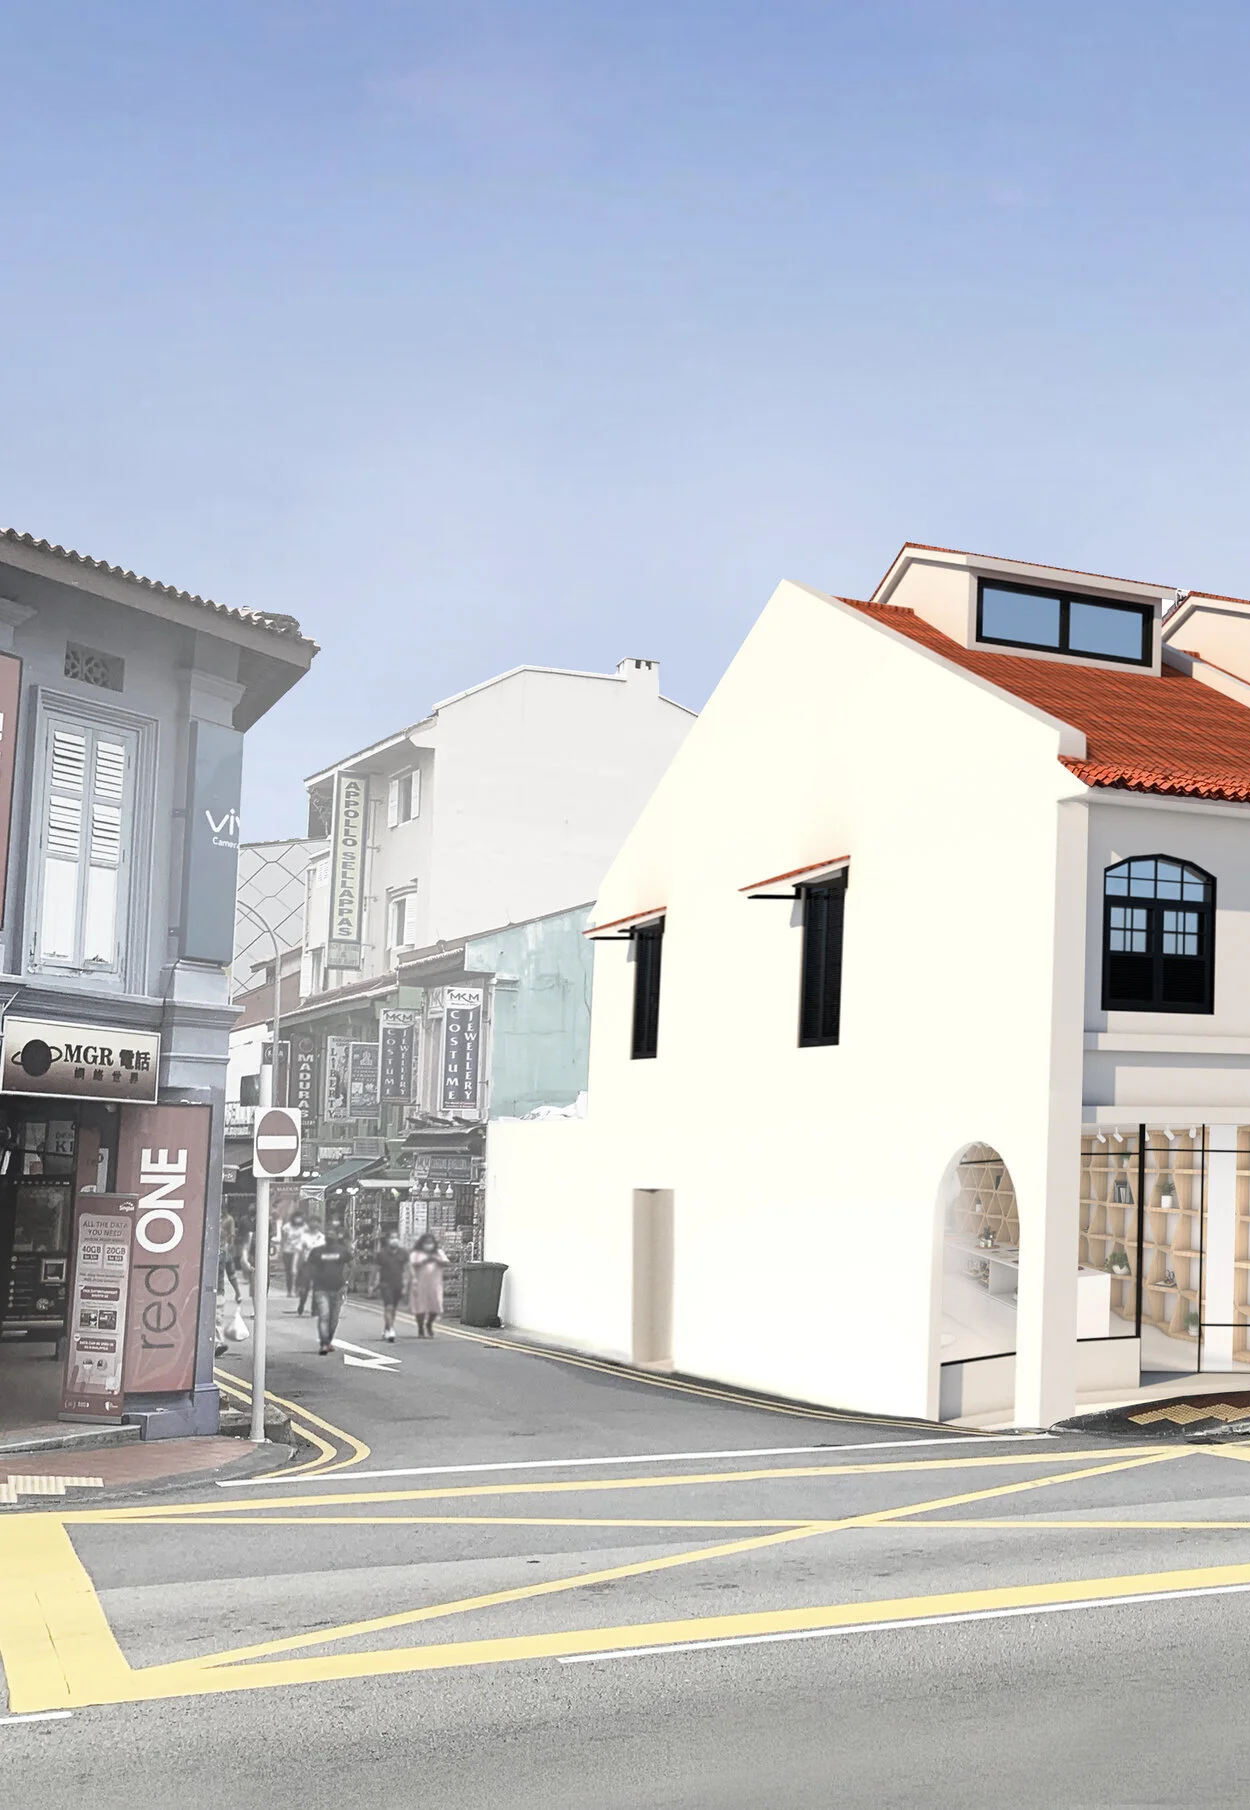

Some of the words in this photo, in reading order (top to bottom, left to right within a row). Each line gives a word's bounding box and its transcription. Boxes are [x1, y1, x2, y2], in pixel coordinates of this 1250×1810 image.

[342, 781, 360, 847] APPOLLO
[337, 851, 357, 937] SELLAPPAS
[386, 1013, 413, 1023] MKM
[450, 992, 480, 1004] MKM
[63, 1043, 114, 1067] MGR
[119, 1049, 151, 1072] 電話
[297, 1053, 314, 1118] MADURAS
[328, 1047, 338, 1119] LIBERTY
[384, 1029, 397, 1095] COSTUME
[445, 1010, 461, 1100] COSTUME
[464, 1011, 478, 1100] JEWELLERY
[82, 1220, 95, 1228] ALL
[96, 1221, 109, 1229] THE
[88, 1228, 103, 1236] YOU
[135, 1148, 188, 1254] ONE
[82, 1245, 101, 1254] 40GB
[106, 1247, 126, 1256] 20GB
[133, 1264, 180, 1350] red
